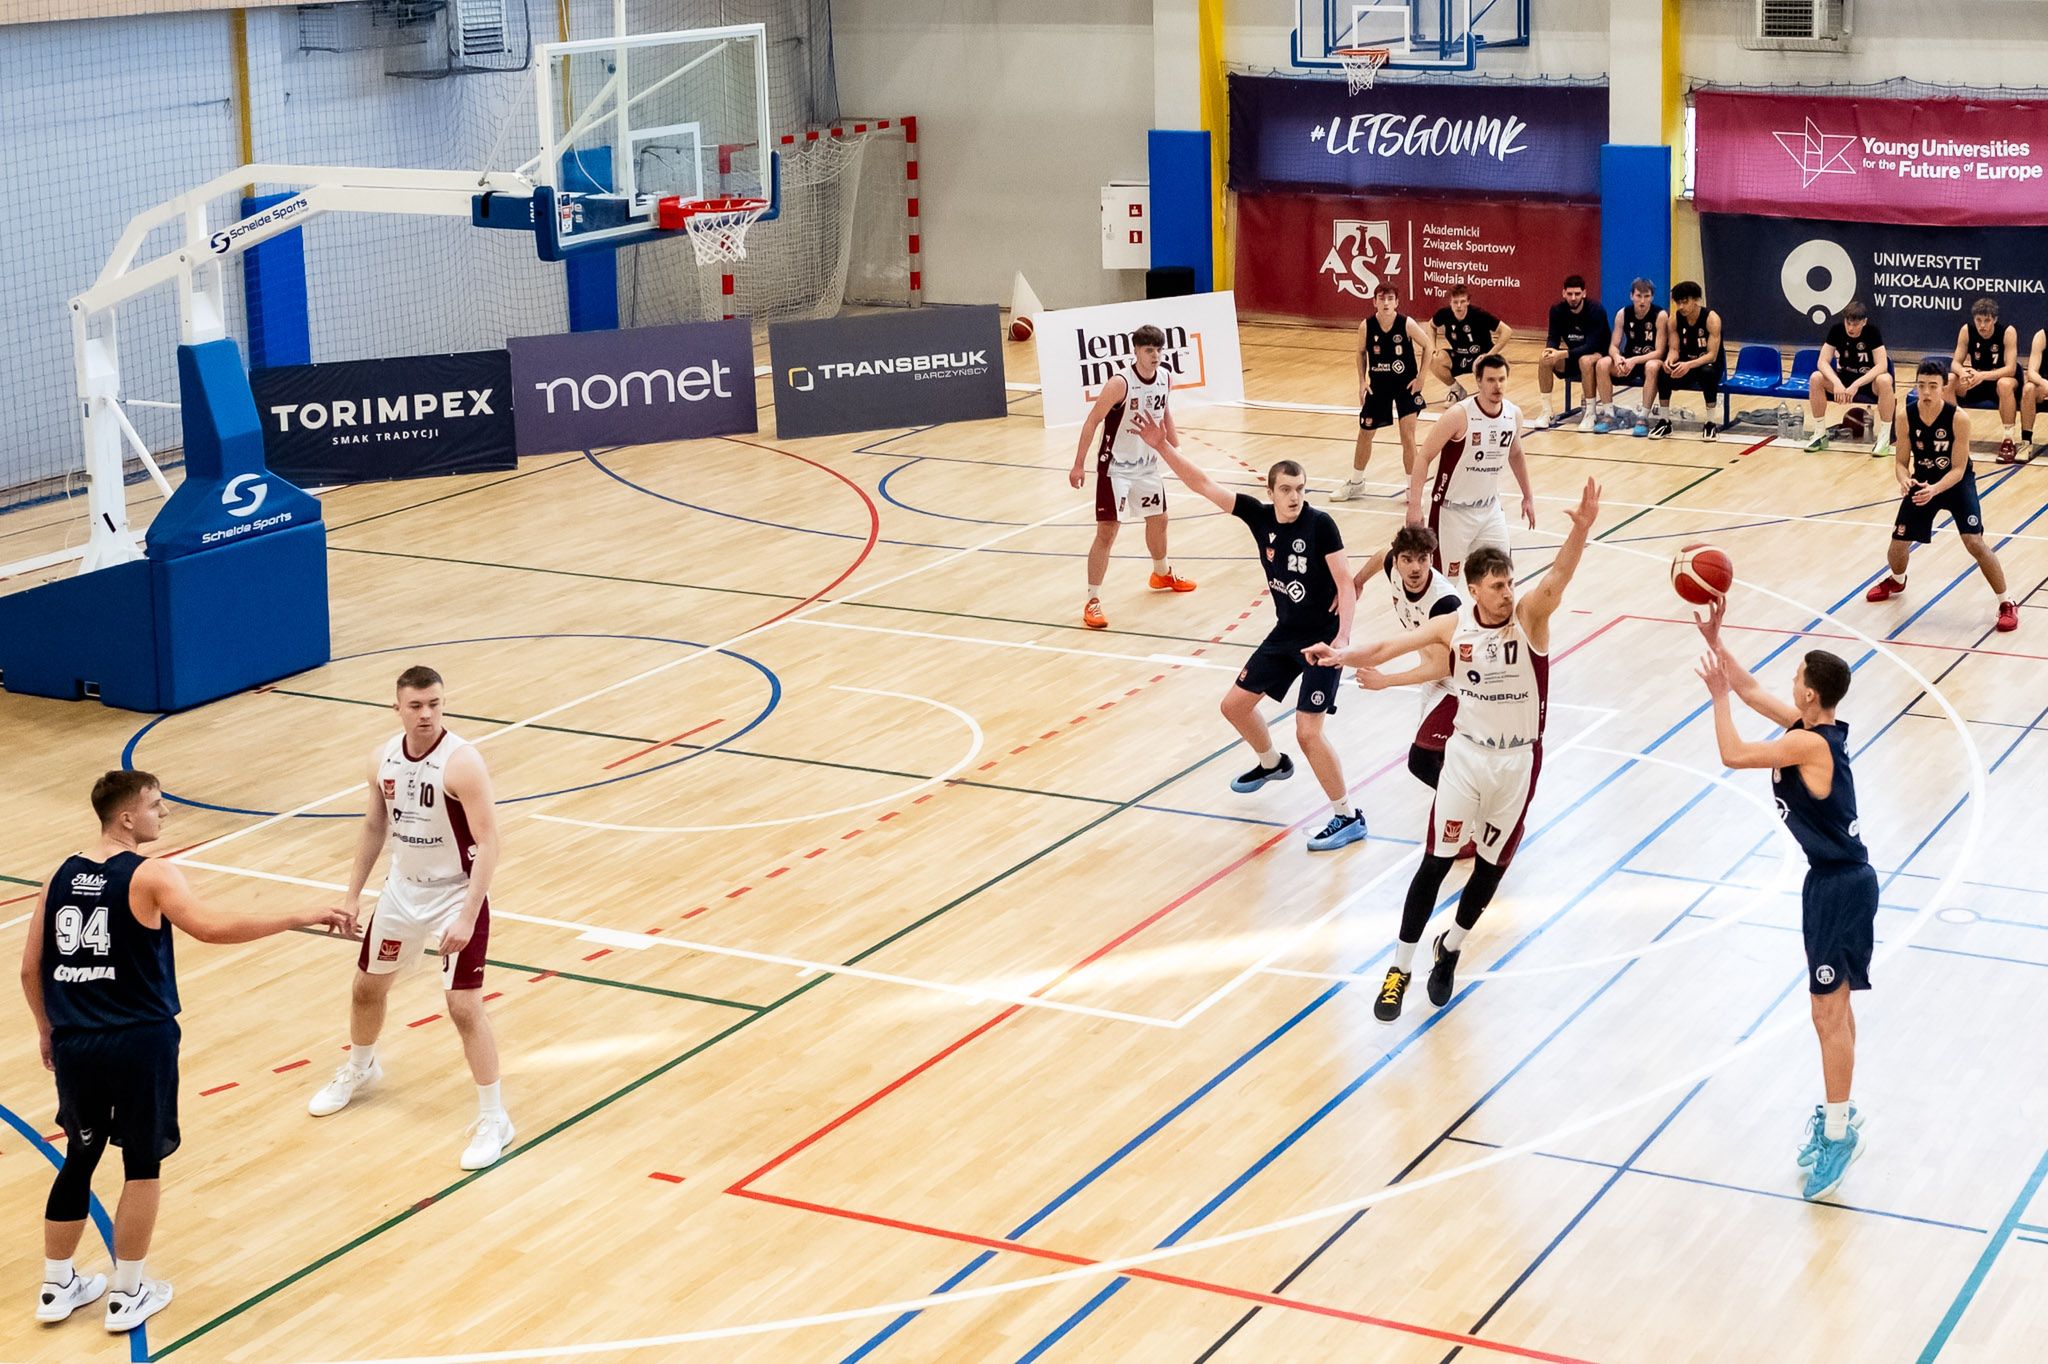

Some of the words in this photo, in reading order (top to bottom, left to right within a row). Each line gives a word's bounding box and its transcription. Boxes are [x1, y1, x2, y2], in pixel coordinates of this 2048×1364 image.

[1310, 113, 1528, 161] #LETSGOUMK
[1862, 137, 1919, 159] Young
[1922, 139, 2030, 158] Universities
[1862, 158, 1876, 168] for
[1879, 159, 1896, 170] the
[1899, 161, 1960, 179] Future
[1963, 162, 1974, 172] of
[1976, 163, 2043, 181] Europe
[230, 215, 271, 239] Schelde
[272, 198, 307, 220] Sports
[1422, 224, 1480, 238] Akademicki
[1422, 238, 1463, 251] Związek
[1466, 241, 1516, 255] Sportowy
[1423, 257, 1489, 272] Uniwersytetu
[1874, 252, 1981, 271] UNIWERSYTET
[1467, 275, 1520, 288] Kopernika
[1874, 273, 1950, 290] MIKOŁAJA
[1953, 276, 2045, 294] KOPERNIKA
[1424, 288, 1433, 296] w
[1874, 293, 1886, 307] W
[1890, 295, 1962, 311] TORUNIU
[1075, 325, 1188, 360] lemn
[818, 350, 988, 379] TRANSBRUK
[914, 366, 989, 381] BARCZYŃSCY
[535, 359, 732, 413] nomet
[271, 389, 494, 432] TORIMPEX
[1154, 394, 1166, 410] 24
[332, 434, 369, 445] SMAK
[375, 428, 439, 441] TRADYCJI
[1500, 431, 1513, 447] 27
[1933, 440, 1949, 452] 77
[1141, 493, 1160, 508] 24
[202, 522, 251, 543] Schelde
[253, 512, 292, 530] Sports
[1287, 554, 1307, 574] 25
[1503, 640, 1518, 664] 17
[1460, 689, 1529, 701] TRANSBRUK
[419, 782, 434, 808] 10
[1483, 822, 1501, 847] 17
[56, 905, 111, 956] 94
